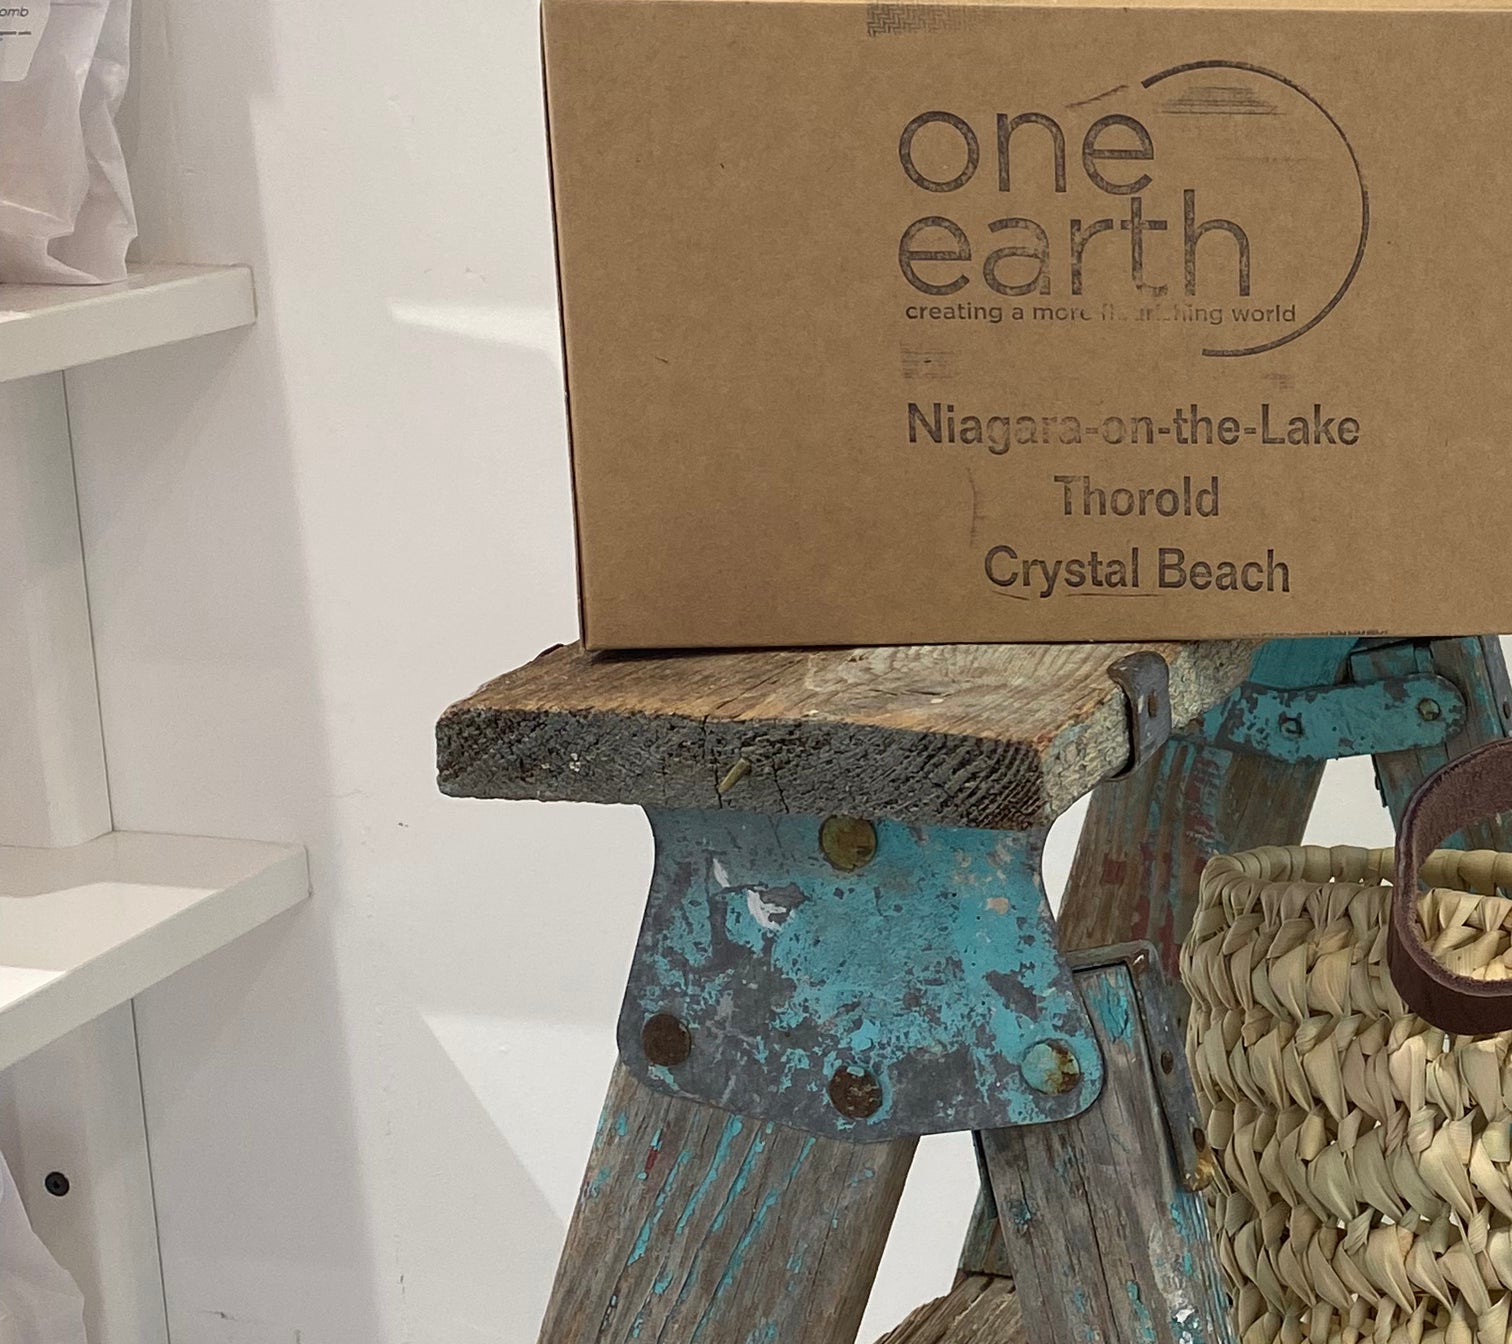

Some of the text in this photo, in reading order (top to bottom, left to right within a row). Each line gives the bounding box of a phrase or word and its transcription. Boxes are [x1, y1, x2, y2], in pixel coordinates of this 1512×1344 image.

[898, 109, 1155, 195] one
[898, 188, 1252, 296] earth
[905, 302, 1003, 324] creating
[1011, 306, 1025, 321] a
[1231, 304, 1296, 322] world
[906, 402, 1361, 456] Niagara-on-the-Lake
[1053, 475, 1220, 517] Thorold
[984, 544, 1291, 599] Crystal Beach
